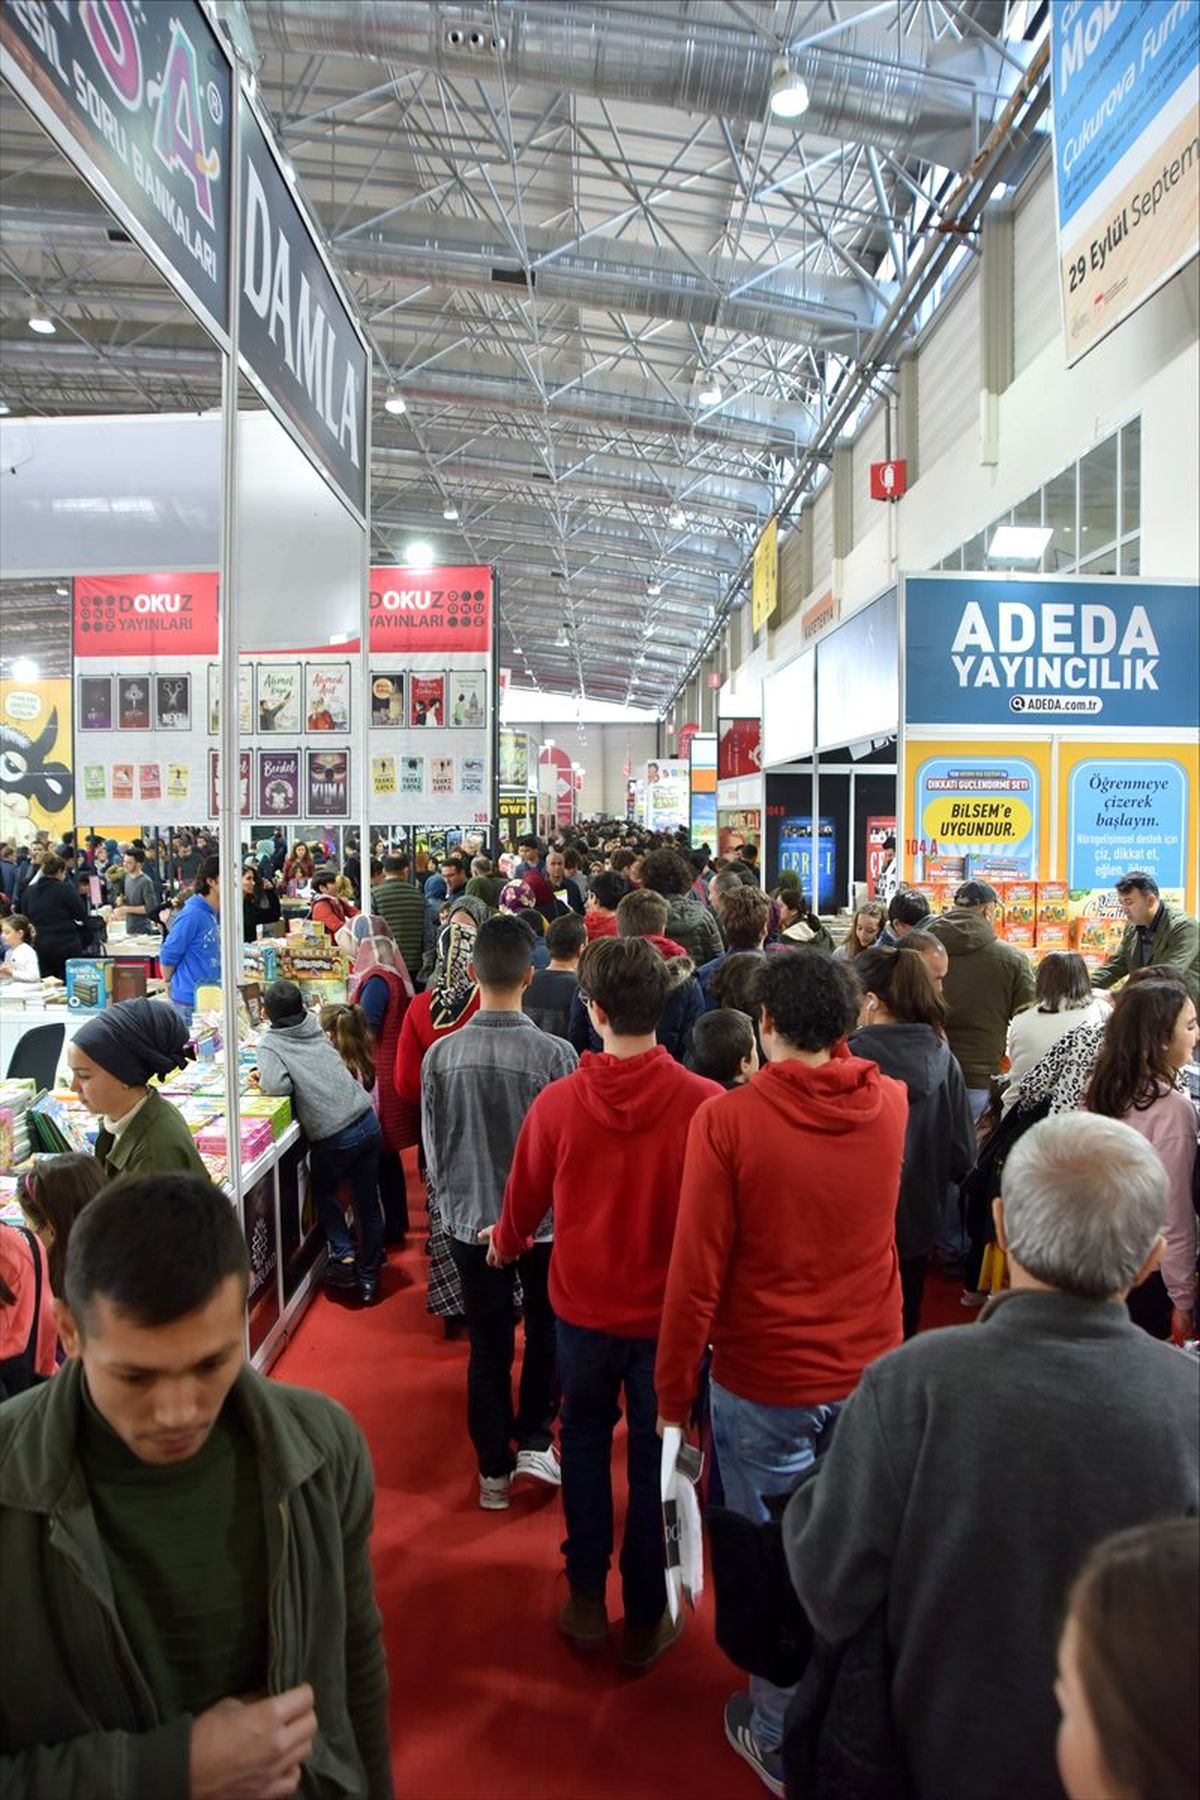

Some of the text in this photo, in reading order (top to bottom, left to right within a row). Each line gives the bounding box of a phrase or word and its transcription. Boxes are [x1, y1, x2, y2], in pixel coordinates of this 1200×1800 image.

[1063, 62, 1135, 175] Çukurova
[72, 59, 128, 167] SORU
[131, 140, 217, 284] BANKALARI
[1068, 255, 1086, 293] 29
[1090, 210, 1128, 271] Eylül
[244, 155, 360, 470] DAMLA
[119, 594, 193, 613] DOKUZ
[369, 590, 445, 610] DOKUZ
[119, 616, 193, 632] YAYINLARI
[368, 613, 444, 628] YAYINLARI
[951, 601, 1160, 656] ADEDA
[951, 655, 1160, 690] YAYINCILIK
[1027, 699, 1098, 711] ADEDA.com.tr
[1089, 772, 1169, 794] Öğrenmeye
[1104, 795, 1153, 812] çizerek
[940, 822, 1016, 837] UYGUNDUR.
[1096, 813, 1160, 830] başlayın.
[905, 838, 938, 855] 104 A
[1113, 847, 1145, 860] dikkat
